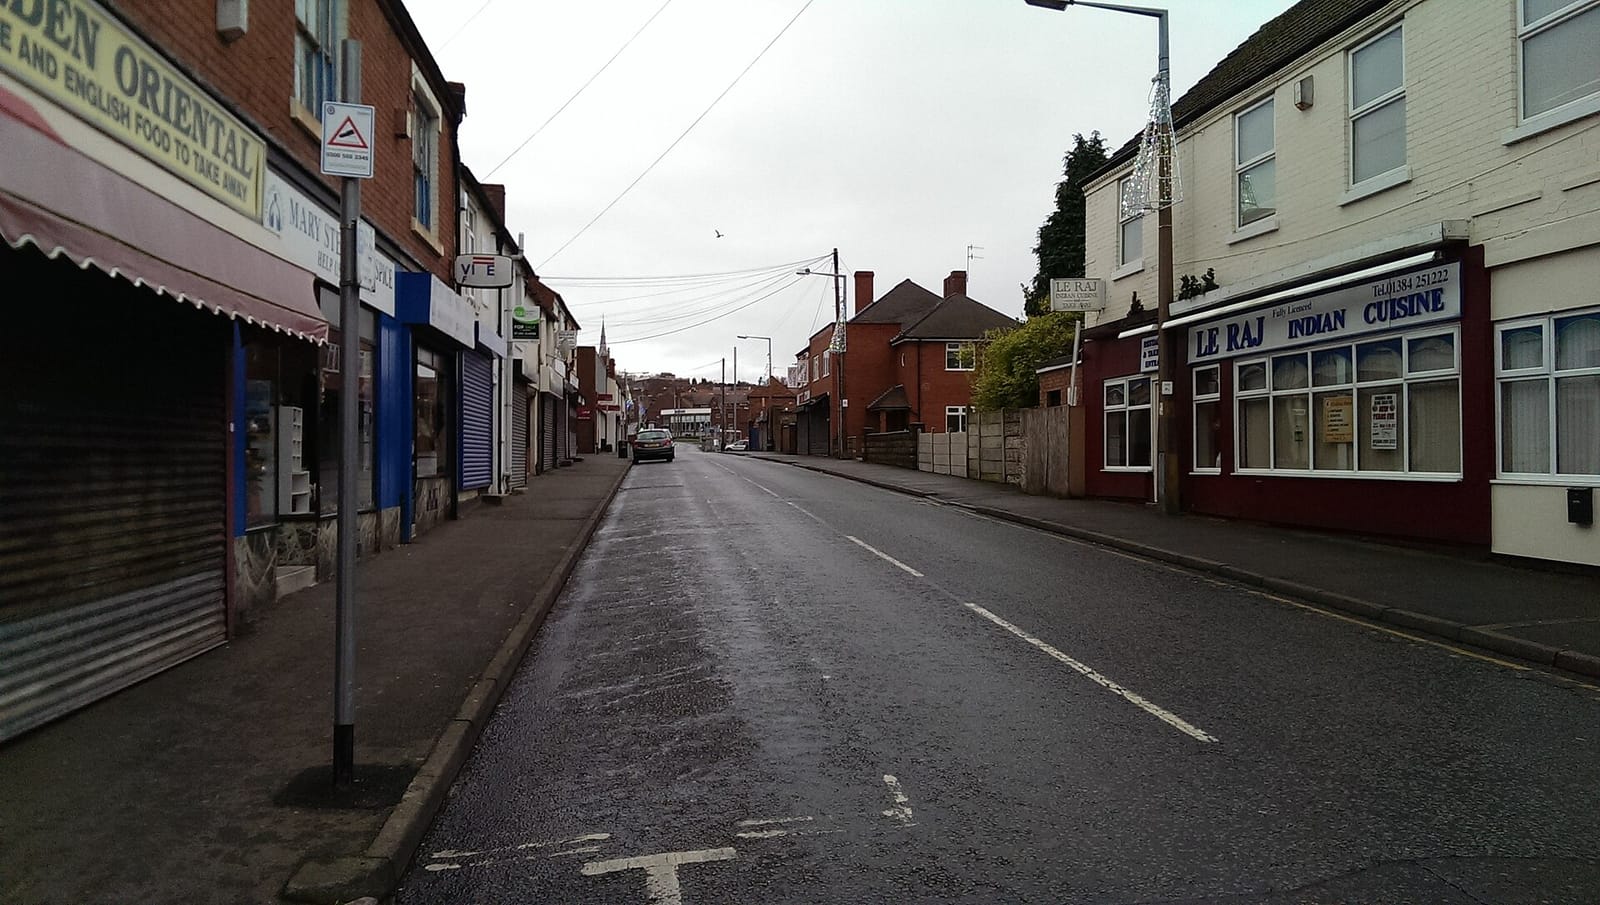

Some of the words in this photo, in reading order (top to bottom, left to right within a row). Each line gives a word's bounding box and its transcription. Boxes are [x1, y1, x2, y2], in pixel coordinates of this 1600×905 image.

[18, 33, 58, 80] AND
[64, 63, 130, 130] ENGLISH
[135, 112, 171, 153] FOOD
[174, 138, 190, 166] TO
[193, 150, 220, 186] TAKE
[222, 171, 248, 204] AWAY
[115, 45, 252, 180] ORIENTAL
[290, 197, 319, 242] MARY
[1056, 281, 1071, 292] LE
[1075, 281, 1097, 292] RAJ
[1415, 269, 1449, 290] 251222
[1196, 327, 1219, 358] LE
[1226, 316, 1265, 352] RAJ
[1288, 309, 1346, 339] INDIAN
[1363, 287, 1445, 325] CUISINE
